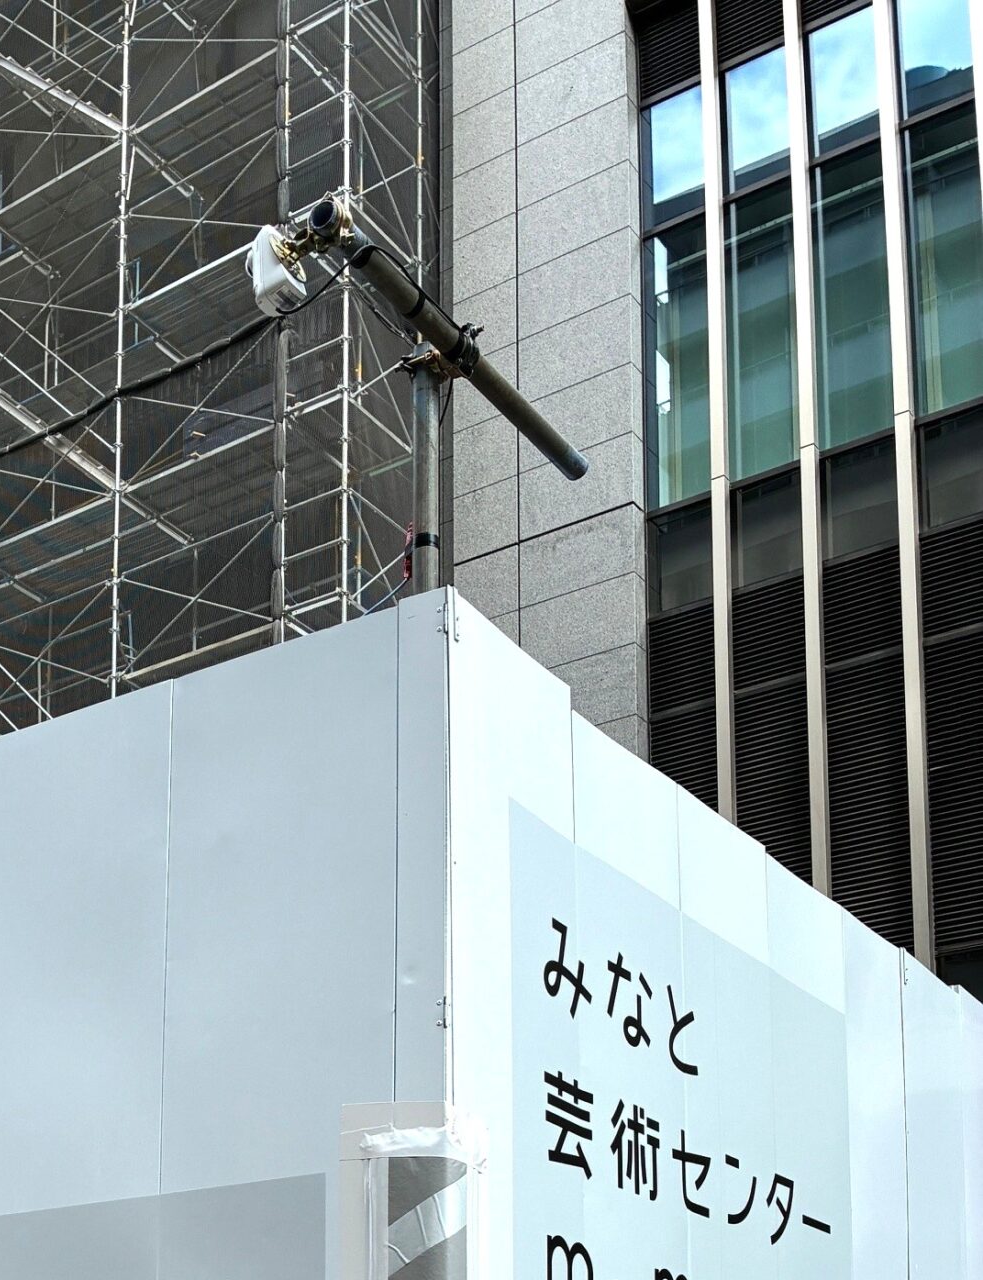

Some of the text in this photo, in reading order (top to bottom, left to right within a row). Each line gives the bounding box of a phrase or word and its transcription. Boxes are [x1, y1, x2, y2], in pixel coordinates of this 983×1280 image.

[543, 917, 699, 1076] みなと
[544, 1070, 831, 1246] 芸術センター
